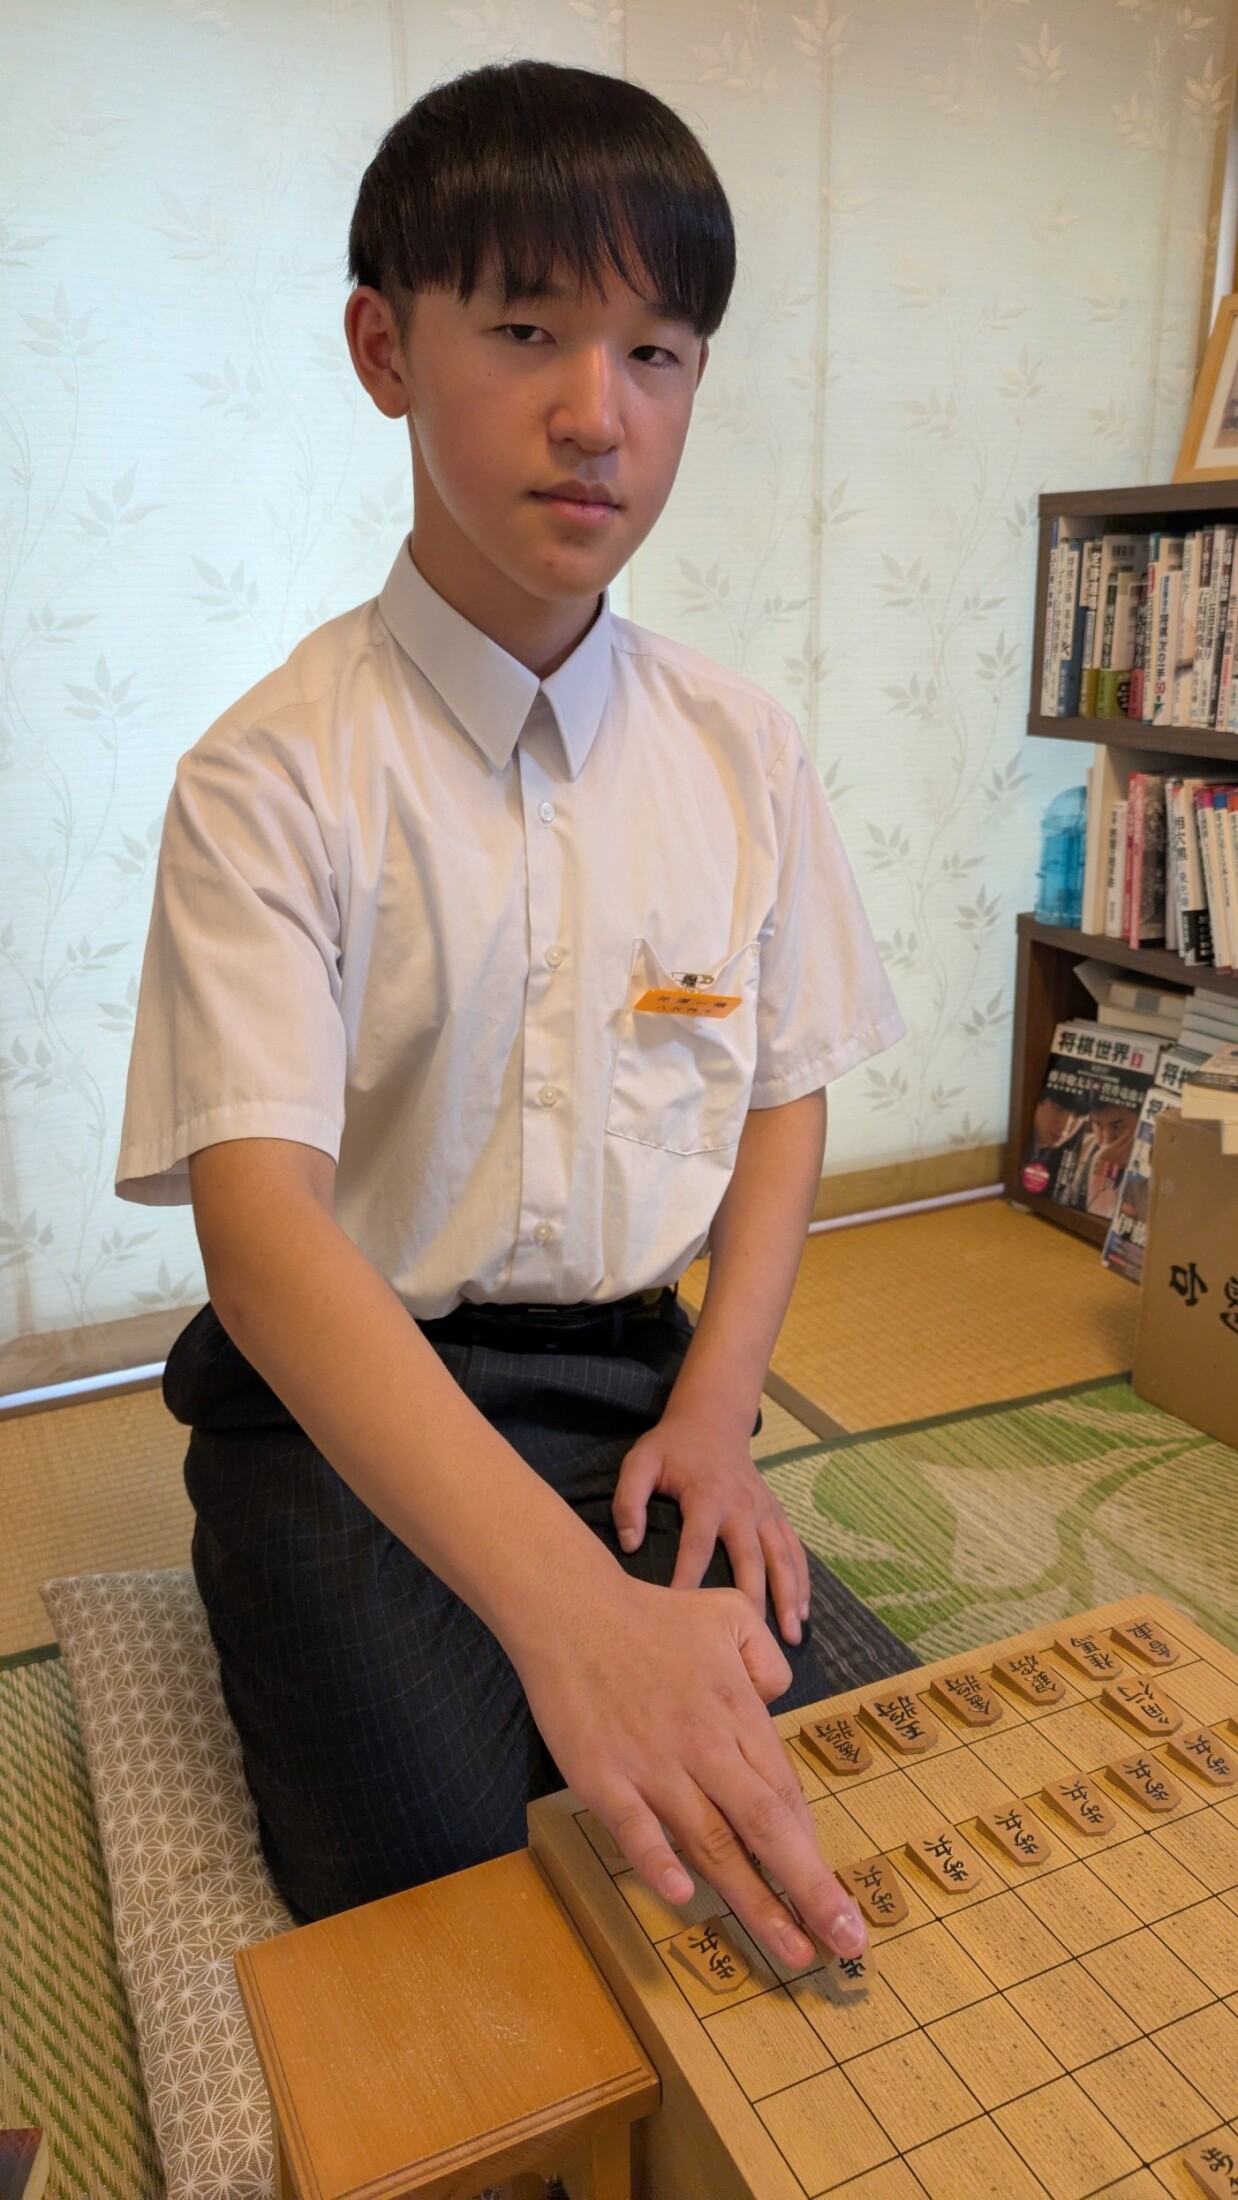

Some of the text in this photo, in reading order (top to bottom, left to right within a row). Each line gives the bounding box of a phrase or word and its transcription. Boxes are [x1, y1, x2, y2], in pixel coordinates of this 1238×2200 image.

[1058, 1030, 1132, 1066] 将棋世界
[1069, 1634, 1115, 1670] 桂馬
[1126, 1622, 1170, 1658] 香車
[1117, 1681, 1170, 1725] 角行
[1183, 1734, 1231, 1776] 歩兵
[1122, 1758, 1170, 1801] 歩兵
[1060, 1782, 1105, 1824] 歩兵
[995, 1805, 1039, 1854] 歩兵
[922, 1831, 975, 1882] 歩兵
[853, 1864, 898, 1915] 歩兵
[688, 1923, 741, 1980] 歩兵
[1200, 2147, 1238, 2196] 歩
